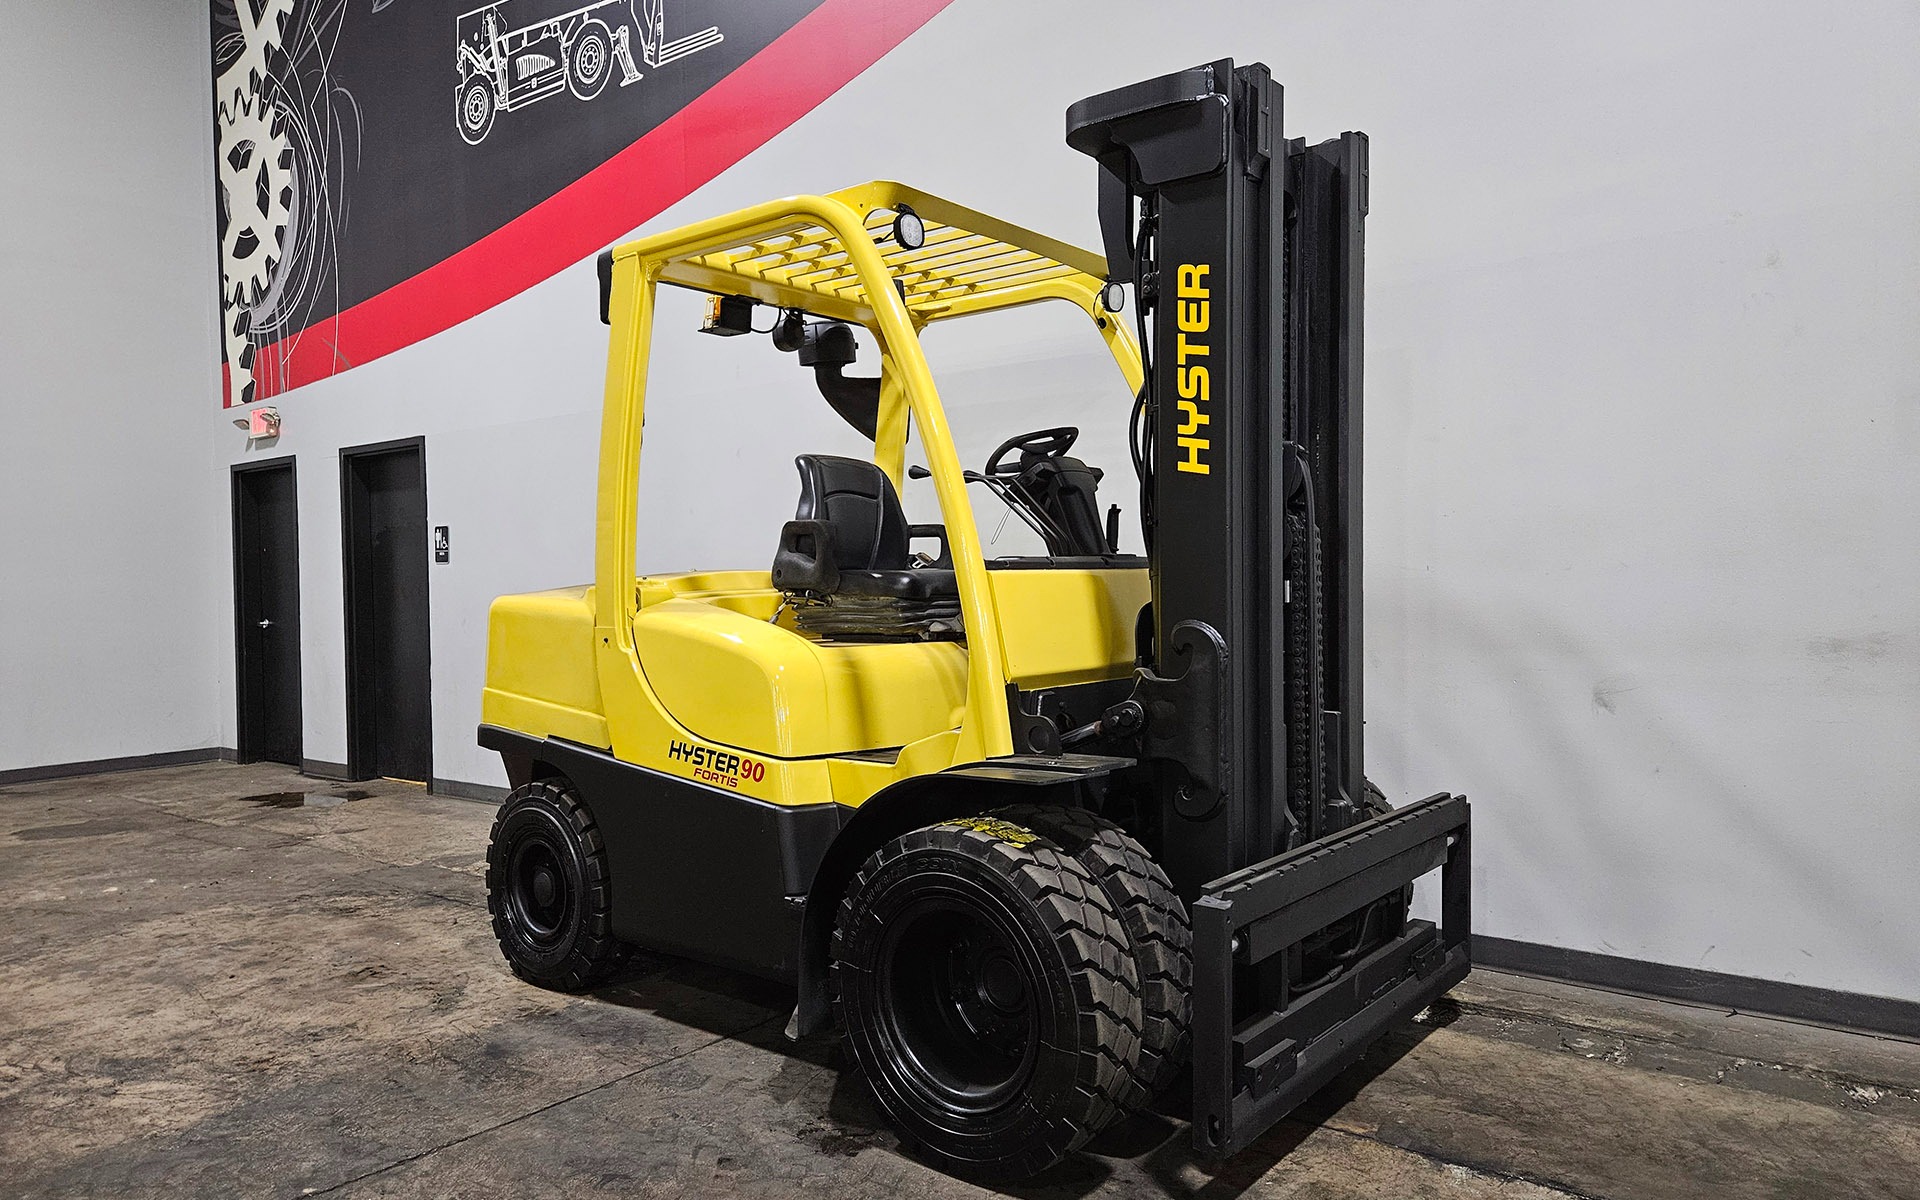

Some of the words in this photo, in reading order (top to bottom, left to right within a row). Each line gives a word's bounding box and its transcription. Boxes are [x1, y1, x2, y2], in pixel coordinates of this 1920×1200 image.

[1177, 263, 1210, 475] HYSTER
[669, 740, 739, 775] HYSTER
[741, 759, 764, 782] 90
[693, 768, 738, 787] FORTIS
